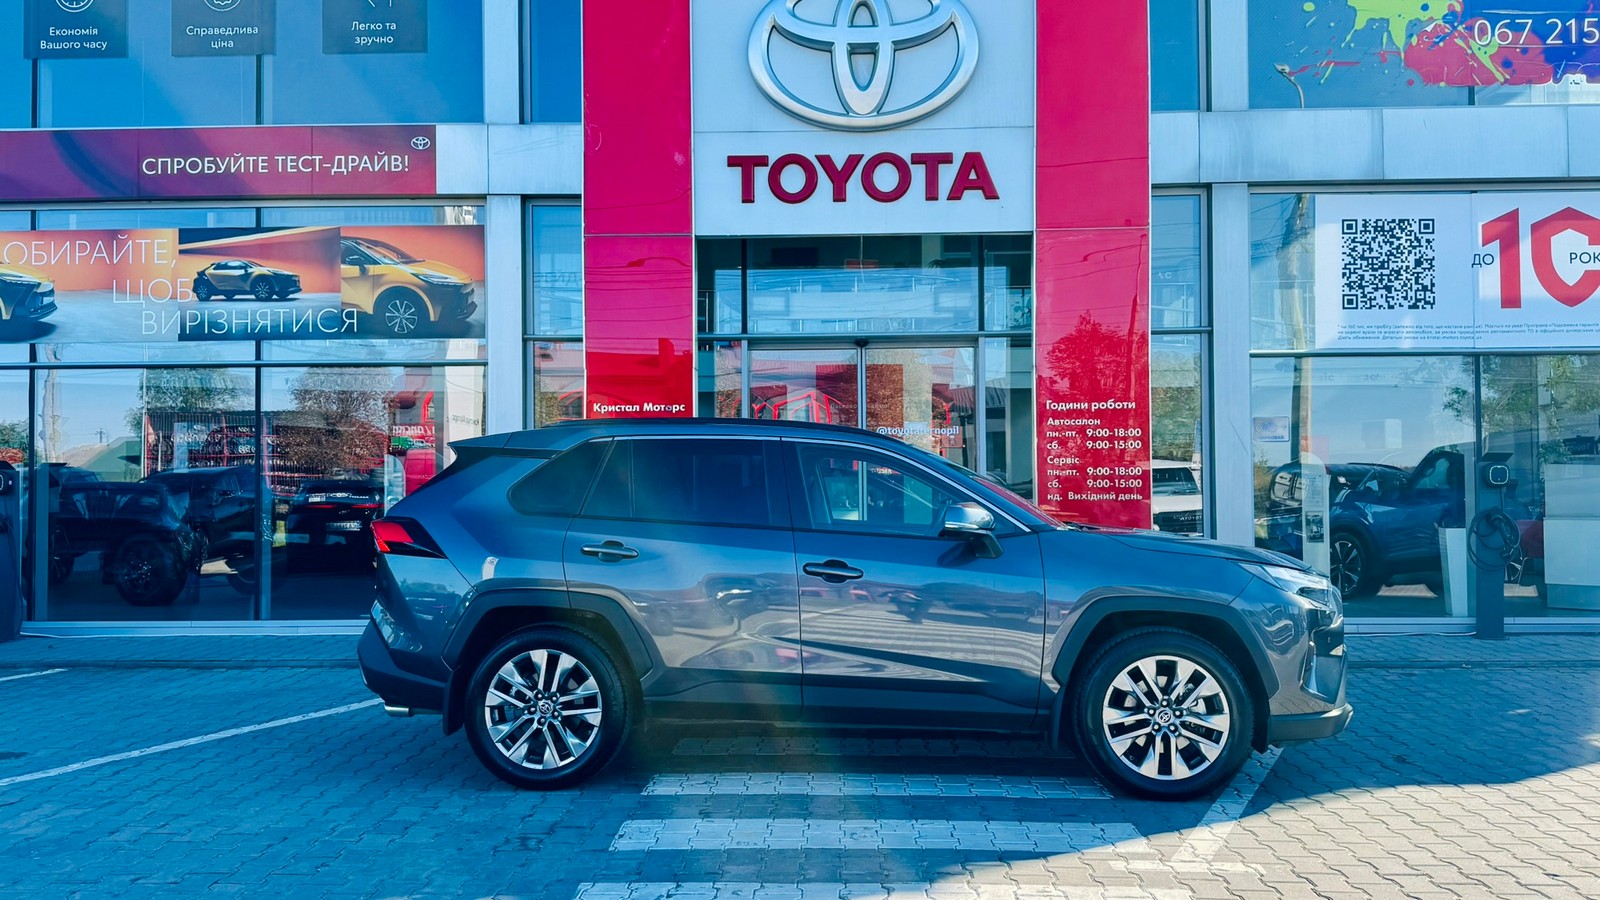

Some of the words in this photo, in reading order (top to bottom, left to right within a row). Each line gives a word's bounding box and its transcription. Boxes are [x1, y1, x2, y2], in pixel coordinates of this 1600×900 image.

[49, 25, 98, 37] Економія
[186, 25, 259, 37] Справедлива
[351, 20, 382, 31] Легко
[1474, 19, 1533, 45] 067
[1545, 18, 1600, 44] 215
[40, 39, 80, 50] Вашого
[83, 40, 108, 51] часу
[211, 38, 234, 50] ціна
[354, 36, 394, 46] зручно
[142, 153, 269, 175] СПРОБУЙТЕ
[274, 151, 410, 175] ТЕСТ-ДРАЙВ!
[727, 151, 1000, 205] TOYOTA
[3, 234, 177, 268] ОБИРАЙТЕ,
[1471, 253, 1495, 268] ДО
[112, 277, 195, 308] ЩОБ
[141, 308, 358, 336] ВИРІЗНЯТИСЯ
[593, 403, 640, 413] Кристал
[643, 402, 686, 413] Моторс
[1046, 400, 1088, 411] Години
[1091, 399, 1136, 412] роботи
[1047, 418, 1101, 426] Автосалон
[1086, 428, 1142, 437] 9:00-18:00
[1046, 441, 1061, 450] сб.
[1086, 440, 1142, 449] 9:00-15:00
[1047, 456, 1080, 466] Сервіс
[1086, 467, 1142, 476] 9:00-18:00
[1047, 479, 1062, 488] сб.
[1086, 479, 1142, 488] 9:00-15:00
[1047, 493, 1063, 502] нд.
[1068, 491, 1116, 501] Вихідний
[1118, 493, 1143, 501] день
